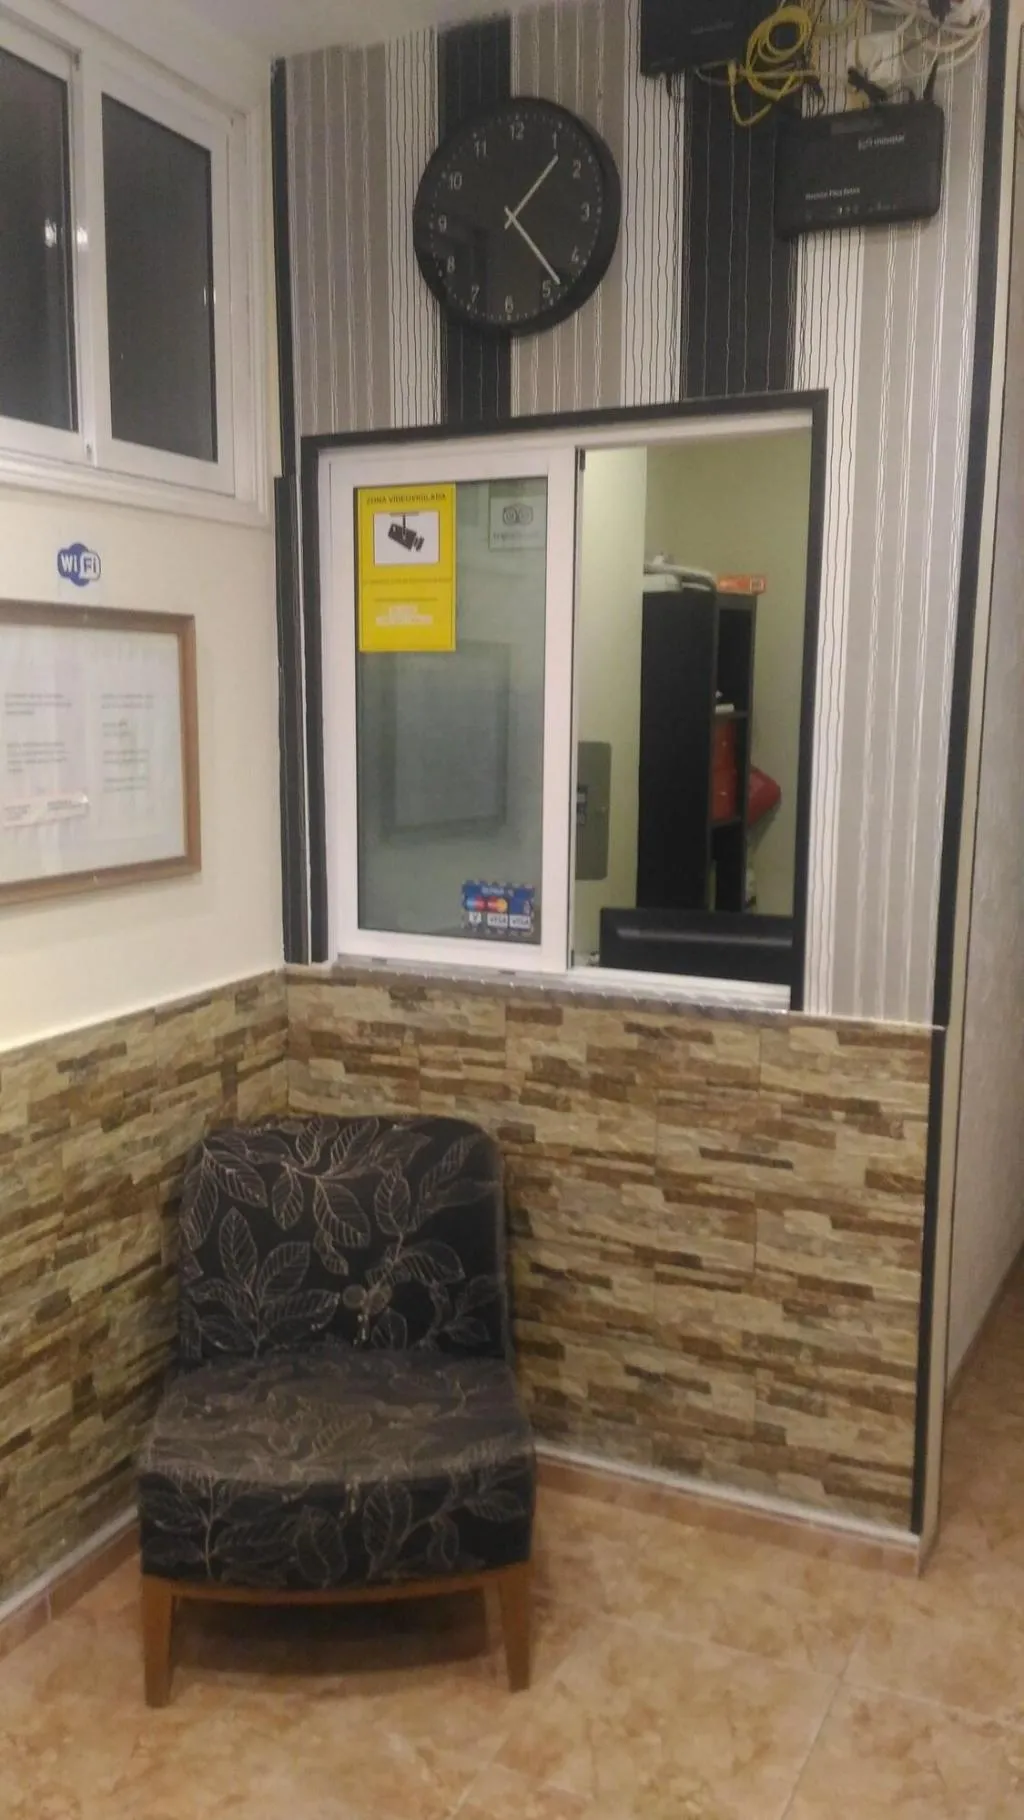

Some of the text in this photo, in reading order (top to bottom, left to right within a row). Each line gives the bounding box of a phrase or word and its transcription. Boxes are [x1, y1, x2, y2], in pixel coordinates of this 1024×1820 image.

[510, 121, 525, 140] 12
[552, 130, 559, 150] 1
[474, 140, 488, 158] 11
[572, 160, 582, 179] 2
[448, 171, 463, 191] 10
[581, 203, 591, 222] 3
[438, 214, 447, 233] 9
[447, 255, 456, 274] 8
[571, 247, 580, 264] 4
[471, 284, 480, 304] 7
[542, 279, 551, 298] 5
[504, 295, 514, 314] 6
